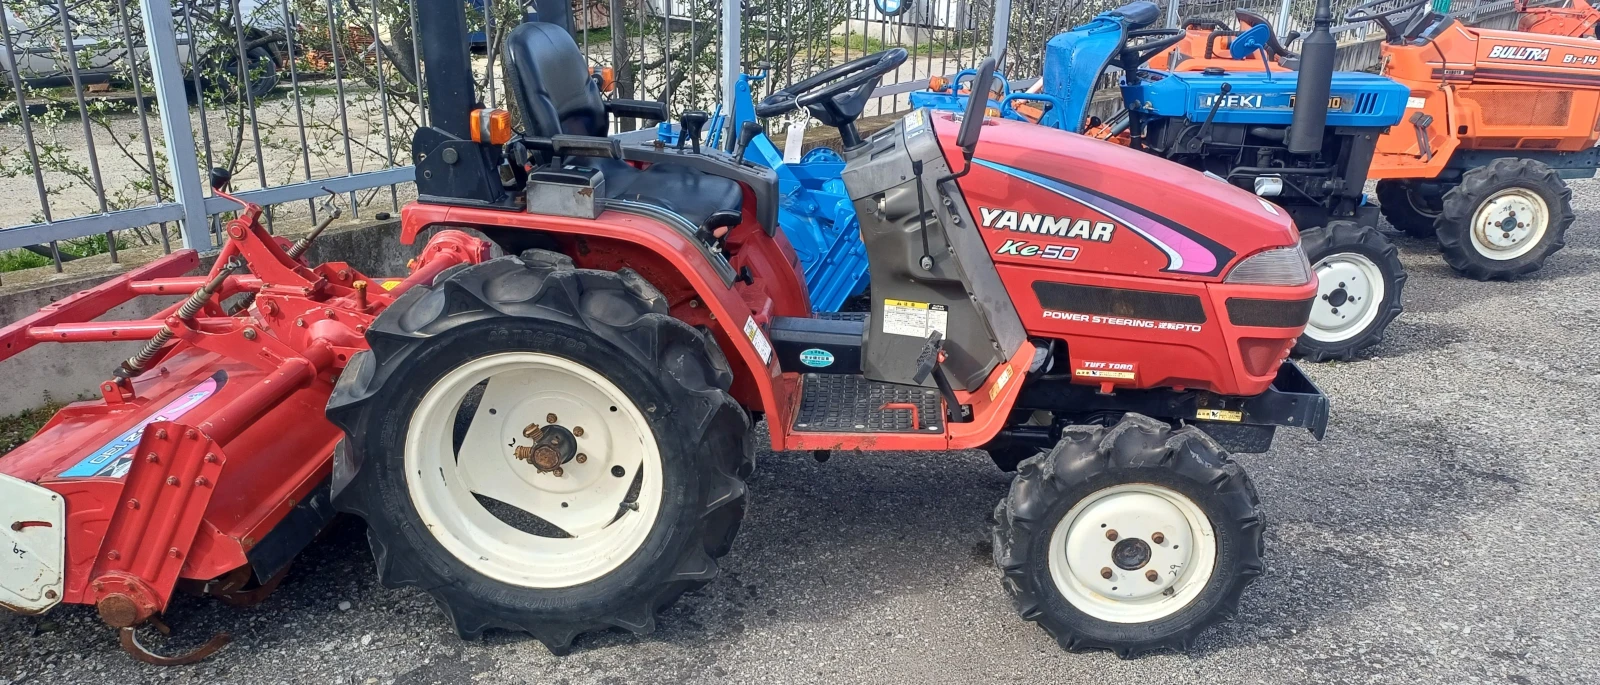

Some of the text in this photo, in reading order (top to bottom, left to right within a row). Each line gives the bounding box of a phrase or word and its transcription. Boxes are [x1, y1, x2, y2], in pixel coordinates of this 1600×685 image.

[1488, 45, 1551, 62] BULLTRA
[1206, 95, 1262, 108] ISEKI
[979, 206, 1116, 243] YANMAR
[996, 239, 1080, 261] Ke-50
[1043, 311, 1090, 323] POWER
[511, 329, 588, 352] TRACTOR
